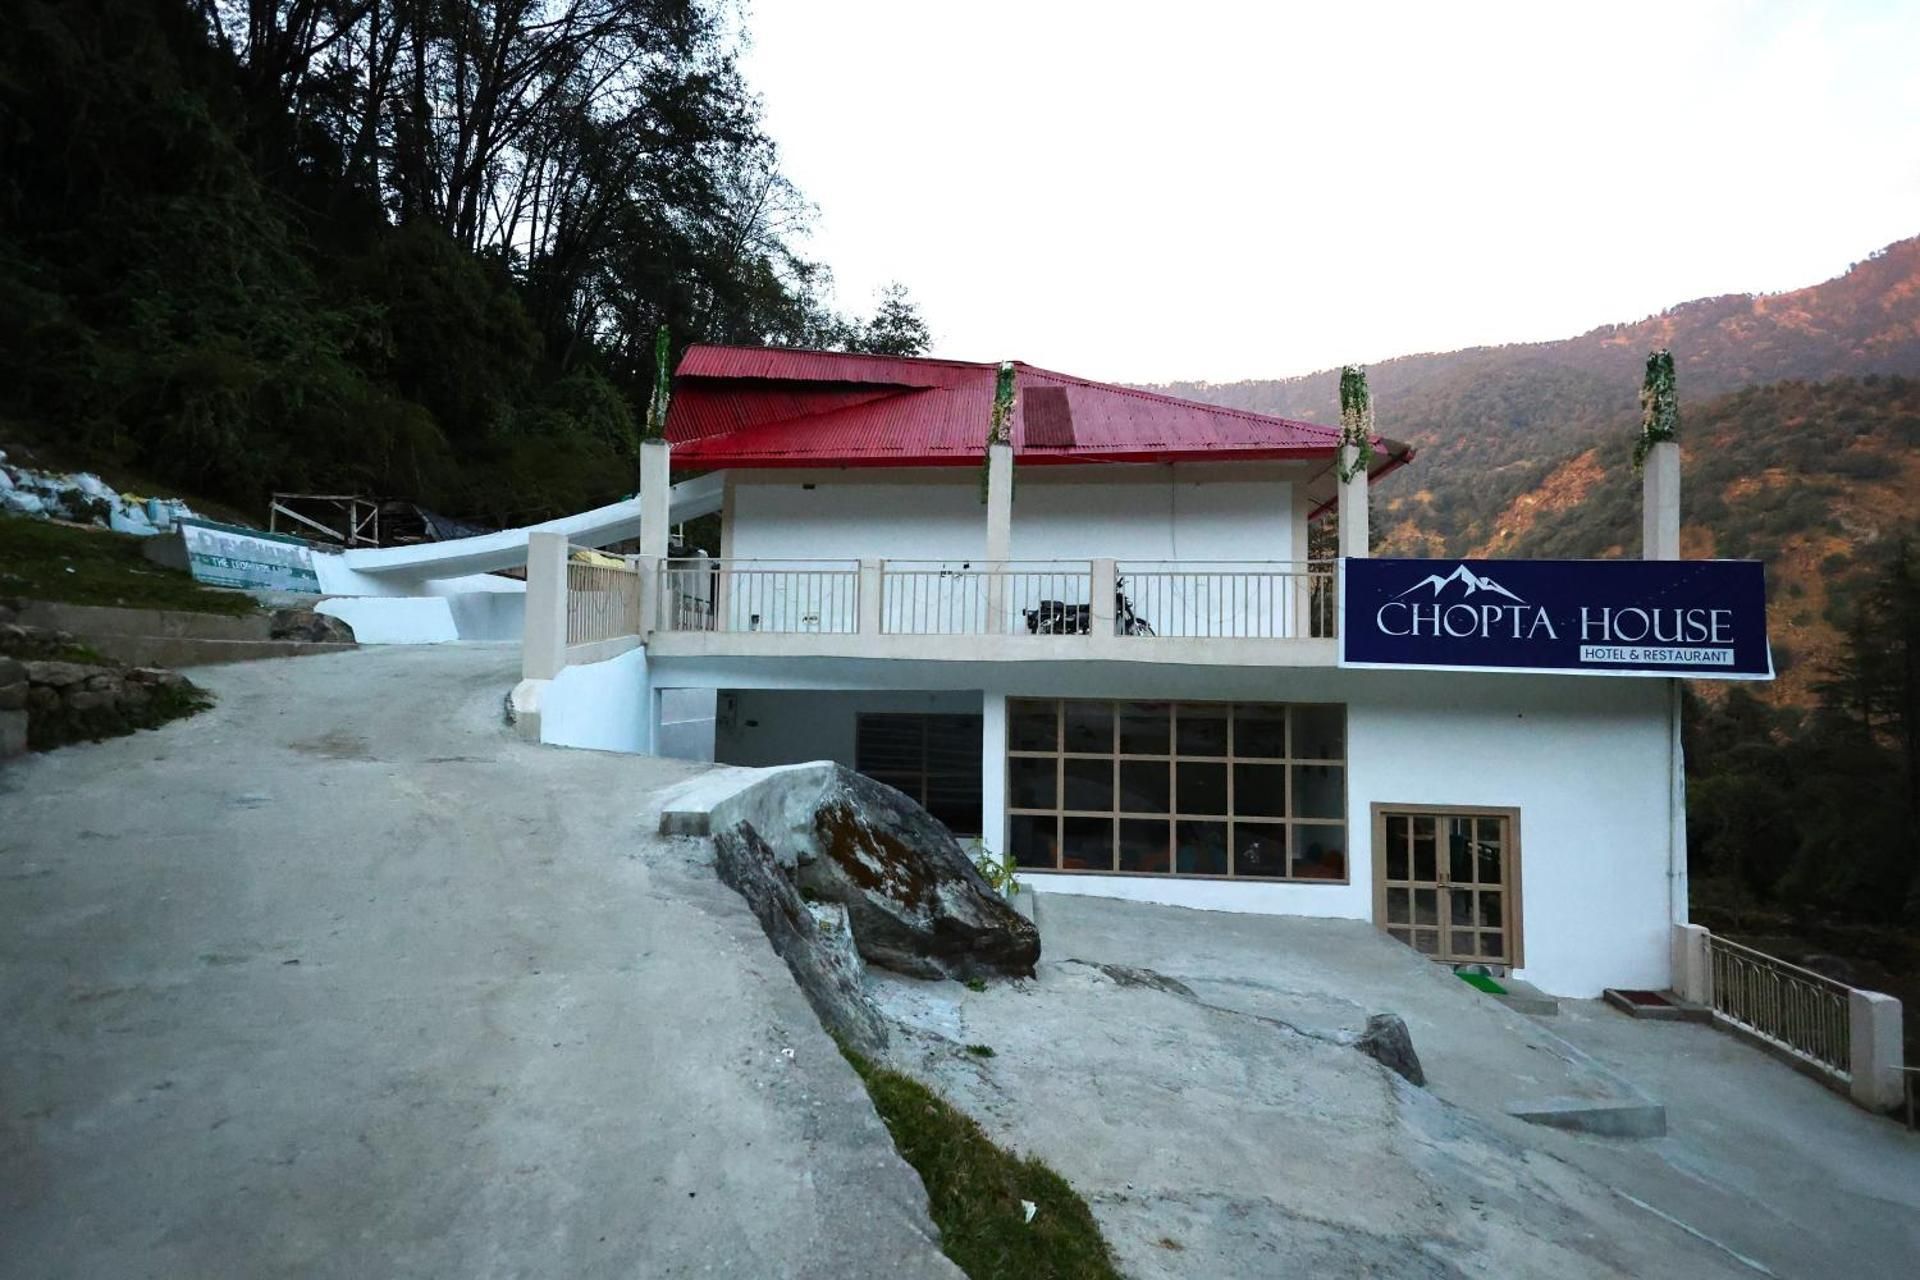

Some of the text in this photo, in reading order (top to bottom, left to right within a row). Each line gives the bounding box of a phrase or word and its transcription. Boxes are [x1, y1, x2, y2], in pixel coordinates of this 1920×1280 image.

[1376, 602, 1734, 643] CHOPTA HOUSE
[1585, 648, 1728, 663] HOTEL & RESTAURANT
